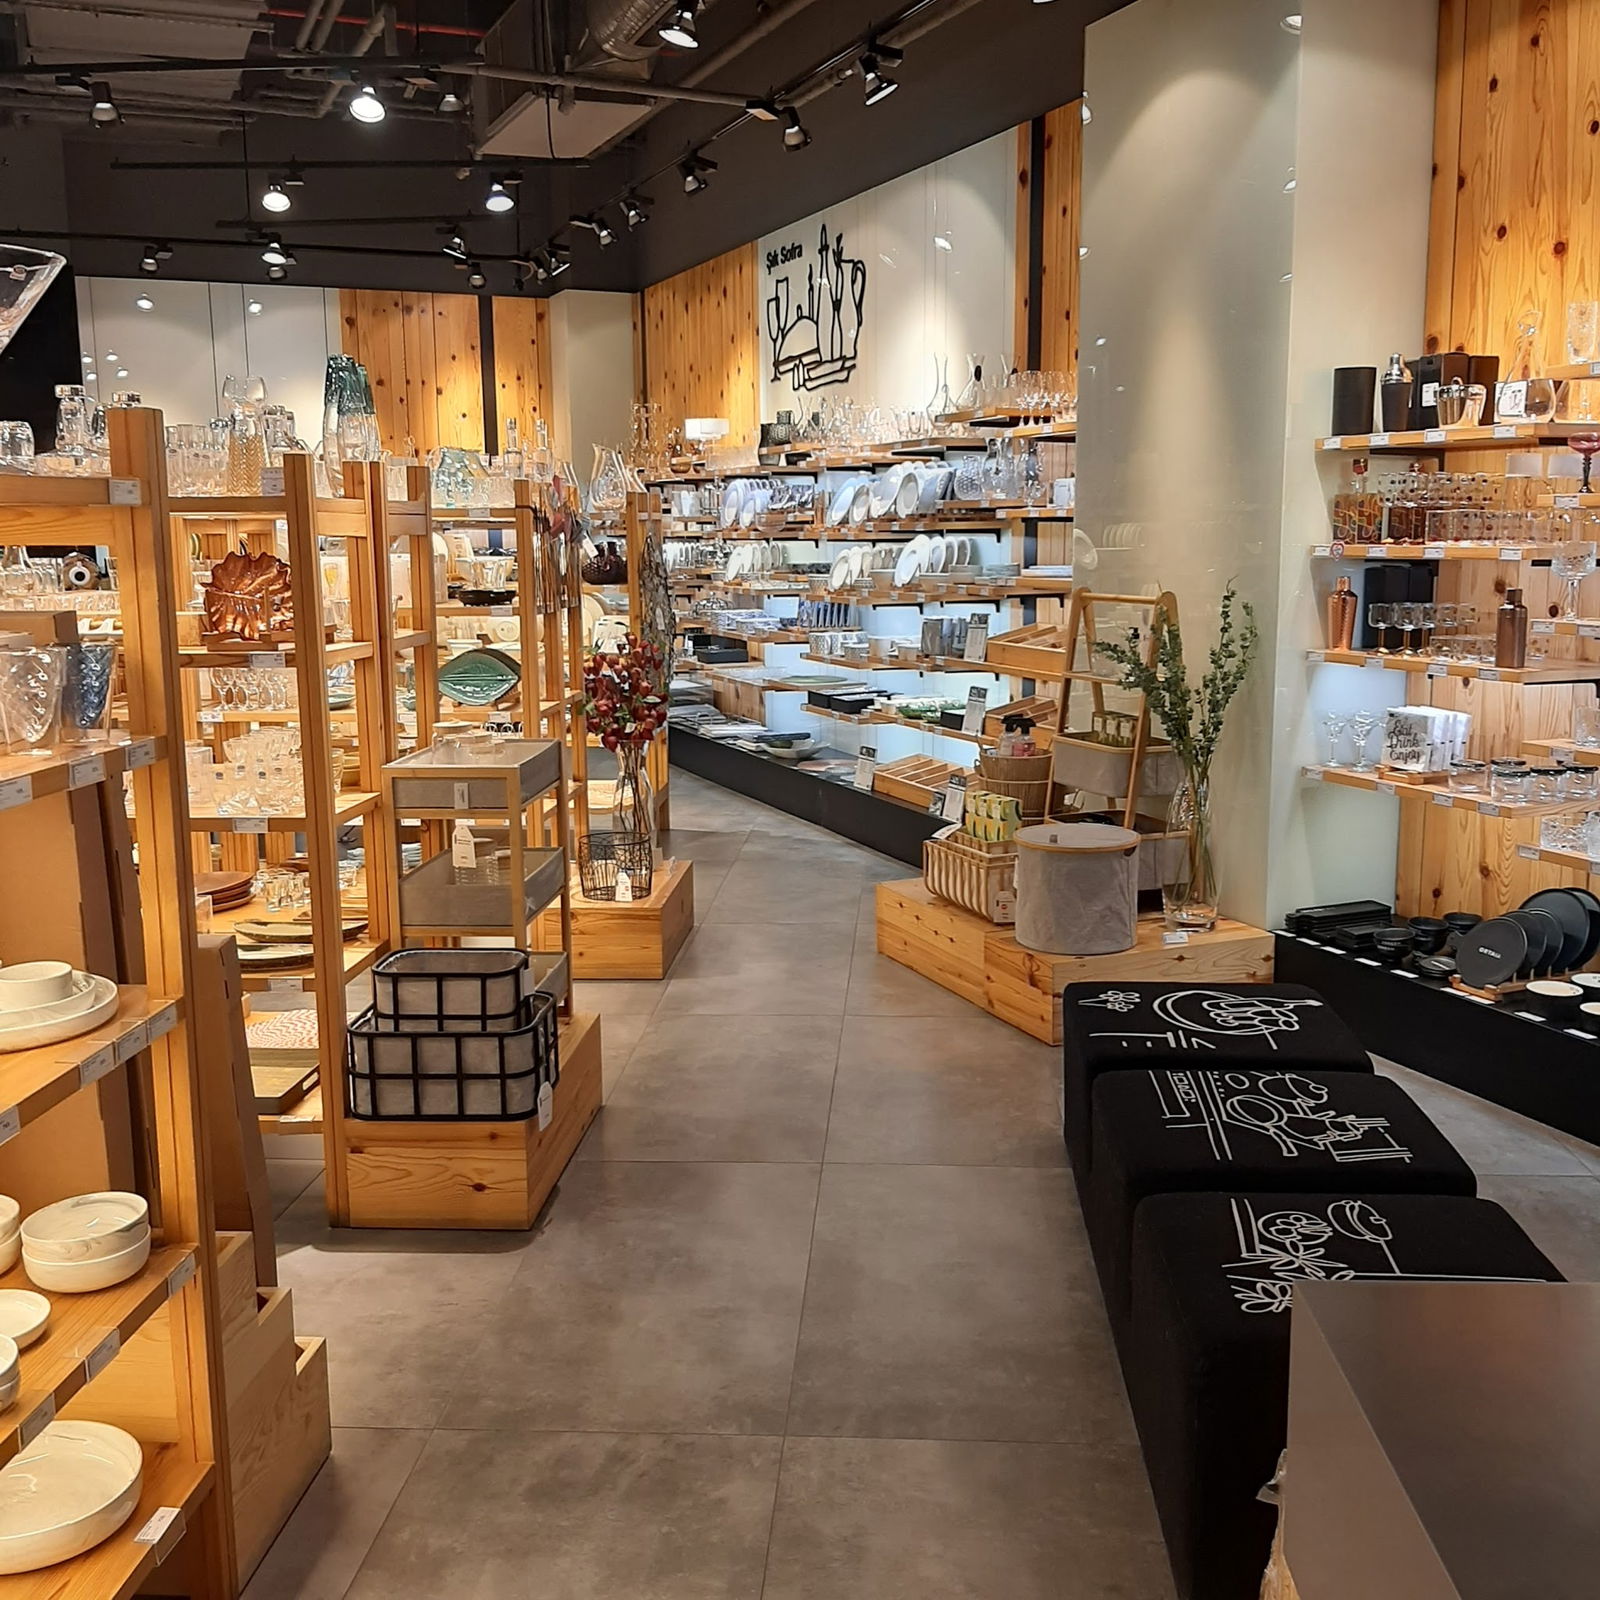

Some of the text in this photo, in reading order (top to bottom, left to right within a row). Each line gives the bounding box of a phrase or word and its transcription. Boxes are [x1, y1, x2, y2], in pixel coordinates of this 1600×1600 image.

[781, 243, 803, 264] Sofra
[1393, 719, 1412, 736] Eat
[1386, 731, 1420, 749] Drink
